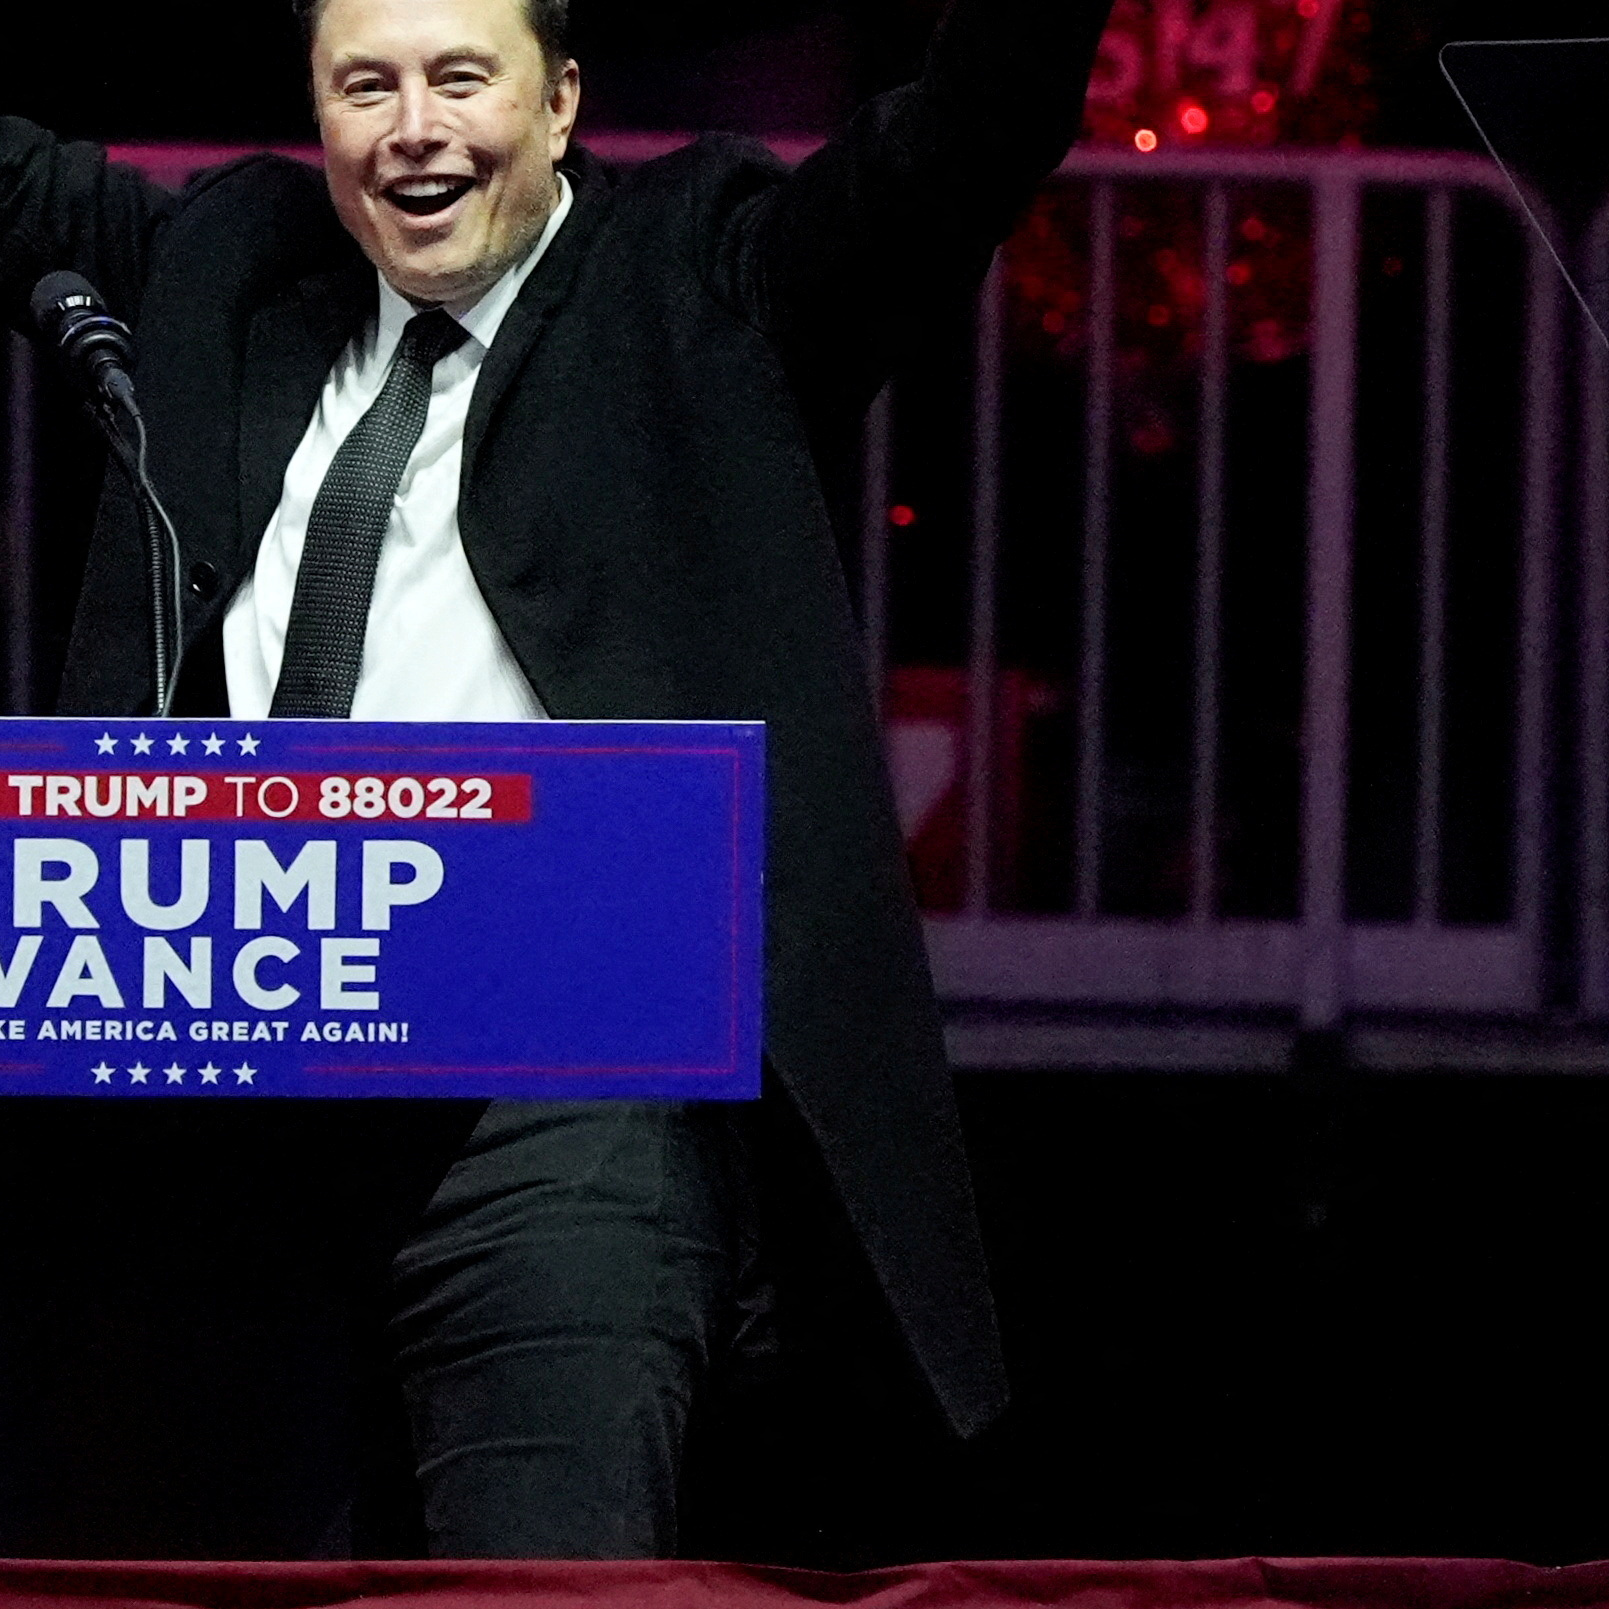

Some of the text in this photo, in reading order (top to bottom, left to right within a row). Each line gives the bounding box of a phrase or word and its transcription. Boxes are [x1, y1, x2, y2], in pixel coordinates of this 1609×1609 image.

[8, 775, 207, 817] TRUMP
[225, 777, 299, 818] TO
[319, 777, 493, 819] 88022
[37, 1019, 178, 1041] AMERICA
[188, 1020, 289, 1042] GREAT
[300, 1021, 409, 1043] AGAIN!
